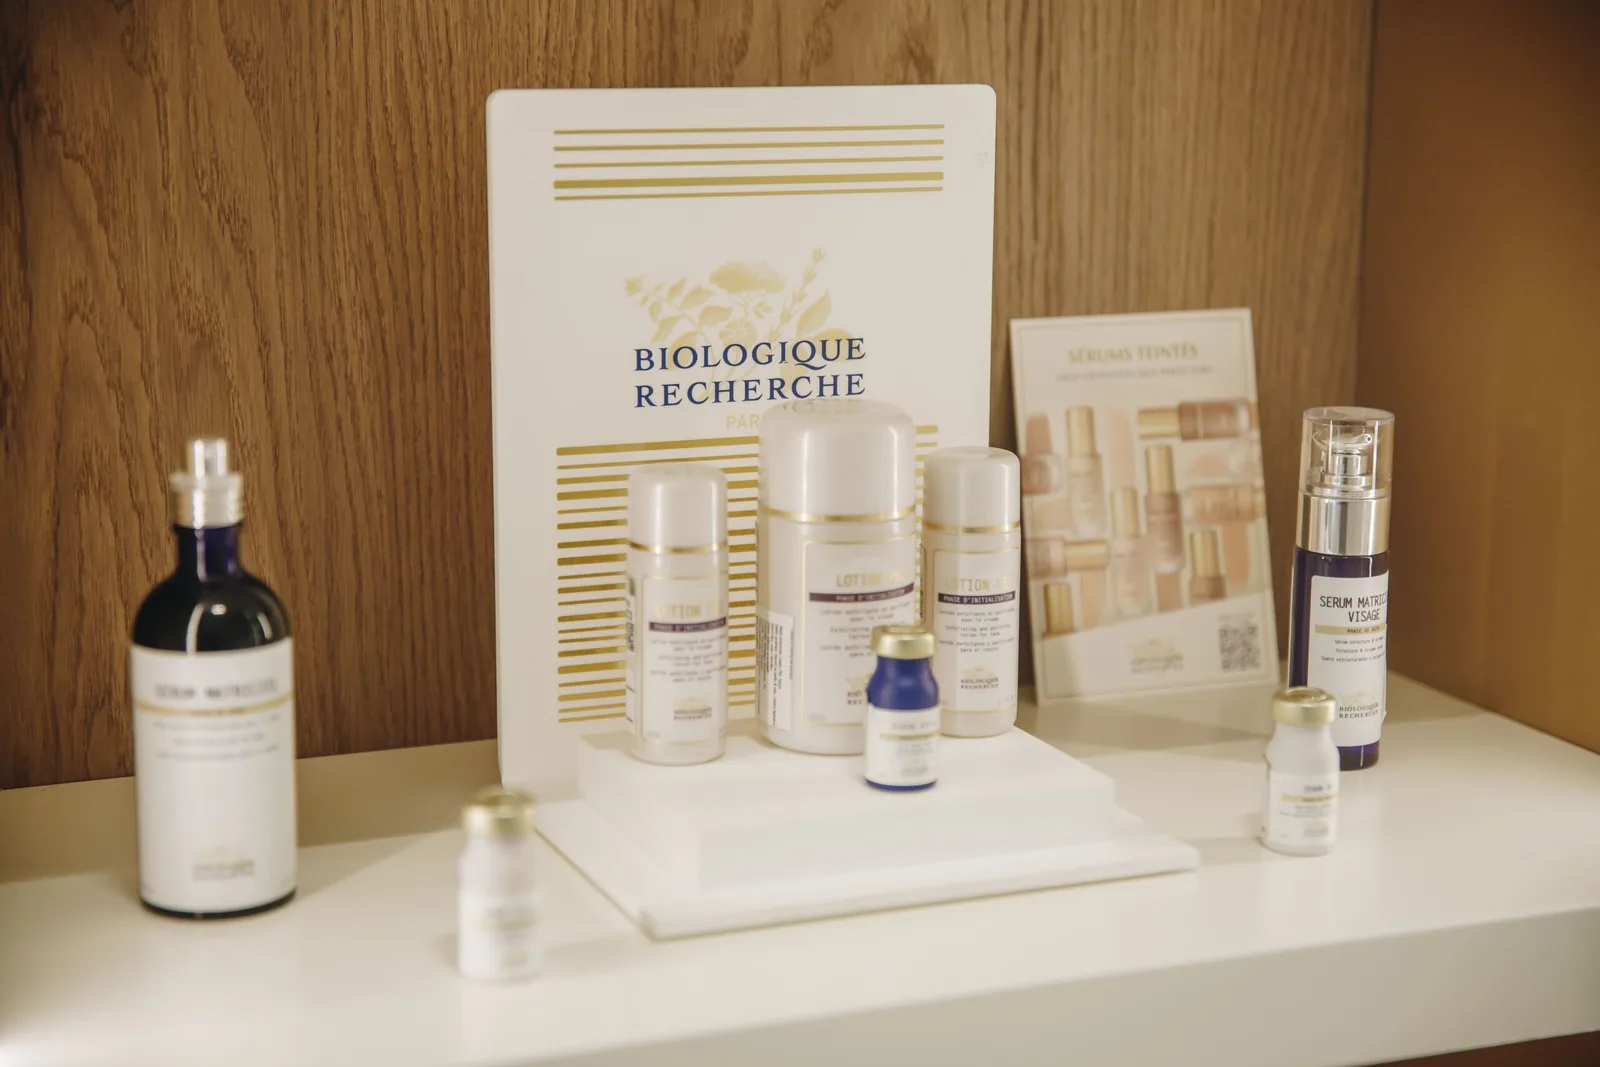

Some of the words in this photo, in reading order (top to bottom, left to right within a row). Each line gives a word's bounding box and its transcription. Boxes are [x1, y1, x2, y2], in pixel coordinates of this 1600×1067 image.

[633, 337, 866, 371] BIOLOGIQUE
[634, 373, 866, 409] RECHERCHE
[963, 592, 1013, 603] D'INITIALISATION
[1320, 595, 1353, 609] SERUM
[1348, 608, 1380, 623] VISAGE
[1339, 702, 1379, 712] BIOLOGIQUE
